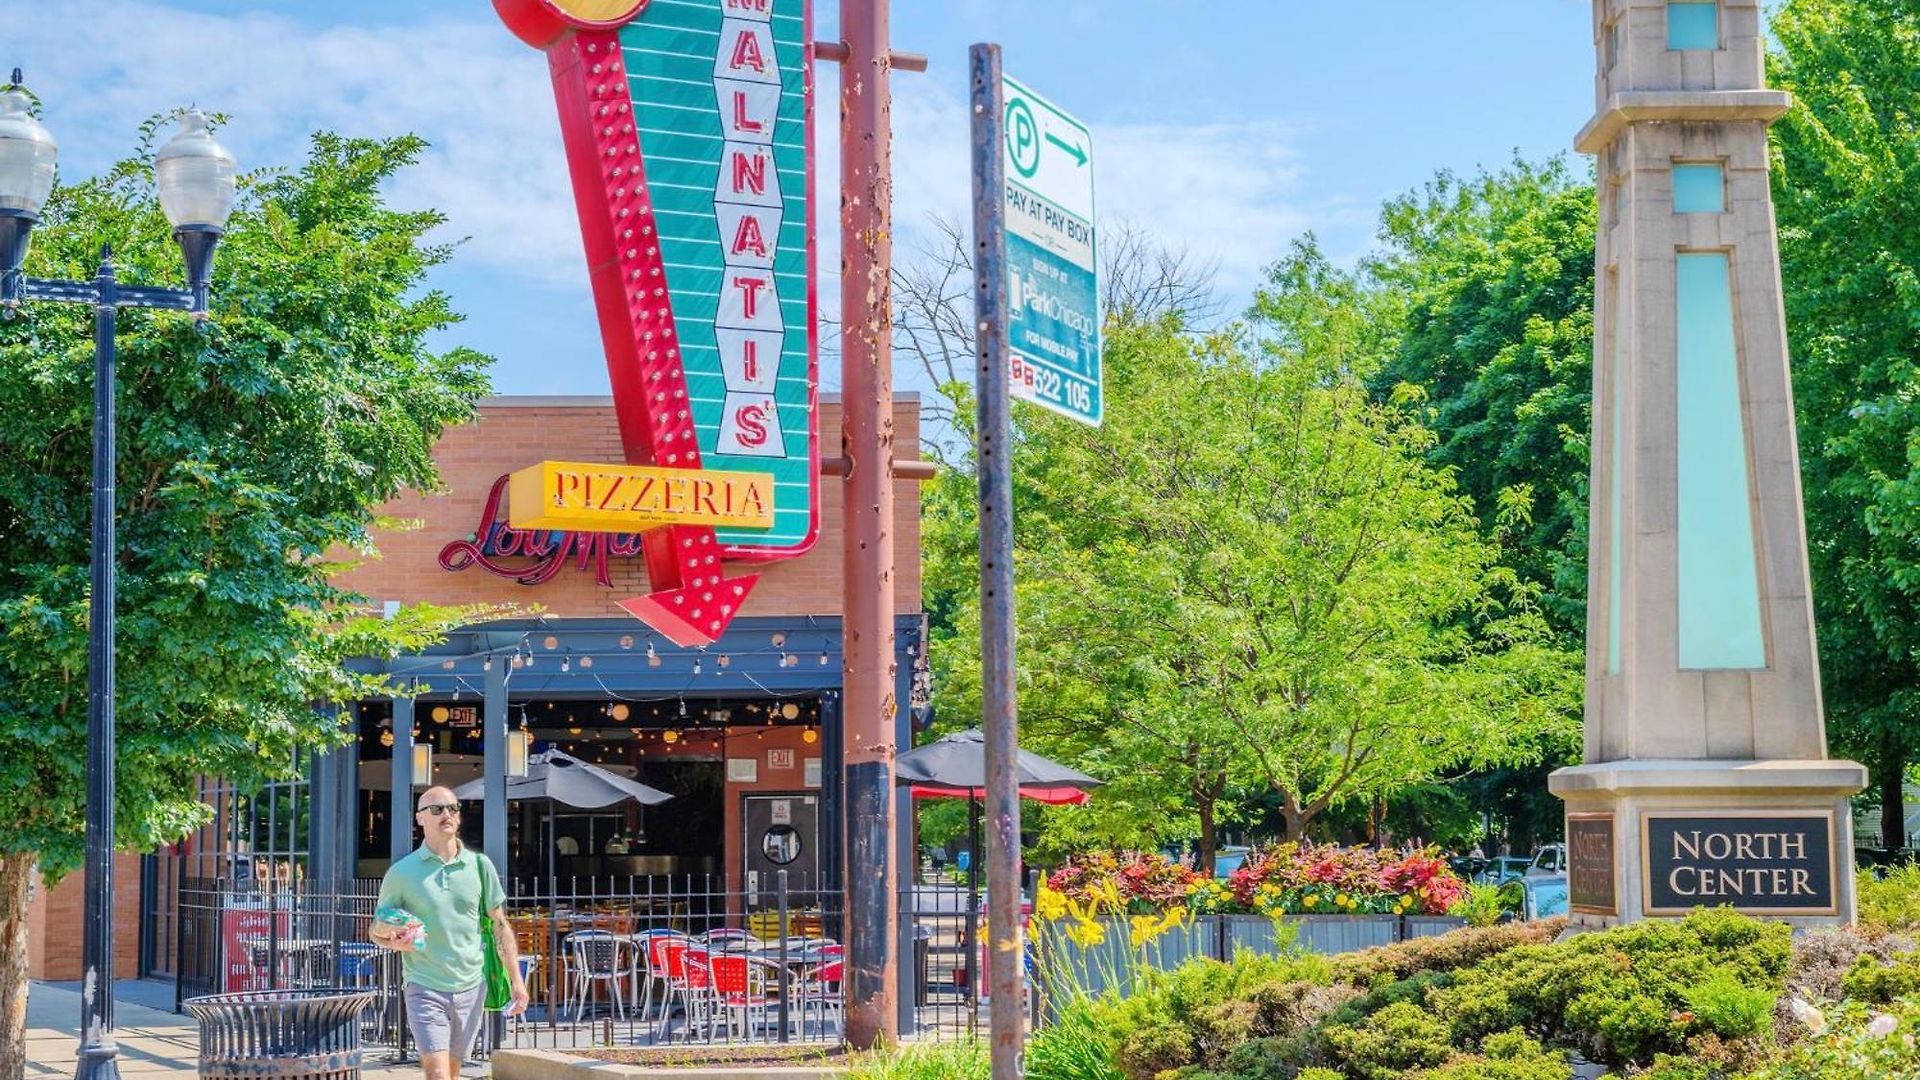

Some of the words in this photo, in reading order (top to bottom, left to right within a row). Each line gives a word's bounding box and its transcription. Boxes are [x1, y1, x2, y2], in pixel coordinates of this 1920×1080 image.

[727, 0, 769, 448] ALNATI'S
[1006, 186, 1026, 213] PAY
[1029, 199, 1042, 221] AT
[1045, 207, 1065, 233] PAY
[1067, 219, 1089, 247] BOX
[1023, 281, 1093, 338] ParkChicago
[1026, 329, 1040, 347] FOR
[1040, 336, 1066, 358] MOBILE
[1035, 364, 1062, 402] 522
[1064, 378, 1091, 413] 105
[552, 472, 768, 517] PIZZERIA
[453, 708, 474, 722] EXIT
[771, 751, 791, 764] EXIT
[1574, 831, 1609, 861] NORTH
[1671, 830, 1807, 860] NORTH
[1668, 866, 1817, 896] CENTER
